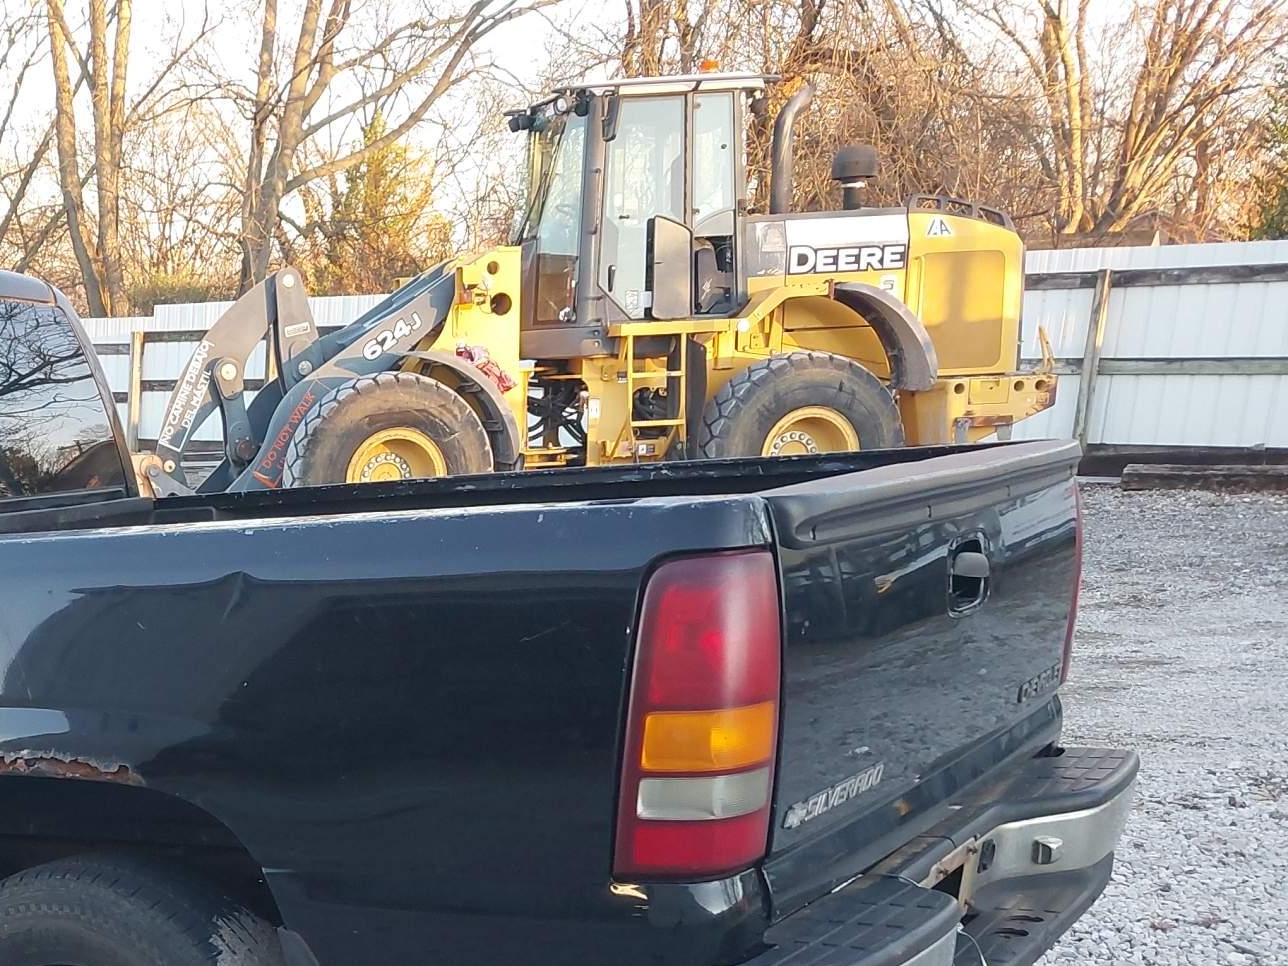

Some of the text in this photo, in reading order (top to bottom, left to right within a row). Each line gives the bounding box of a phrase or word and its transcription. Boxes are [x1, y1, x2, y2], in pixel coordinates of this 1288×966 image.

[789, 245, 906, 274] DEERE
[363, 312, 422, 360] 624J
[160, 424, 175, 444] NO
[263, 450, 277, 469] DO
[275, 425, 293, 450] NOT
[291, 391, 314, 424] WALK
[804, 763, 885, 822] SILVERADO
